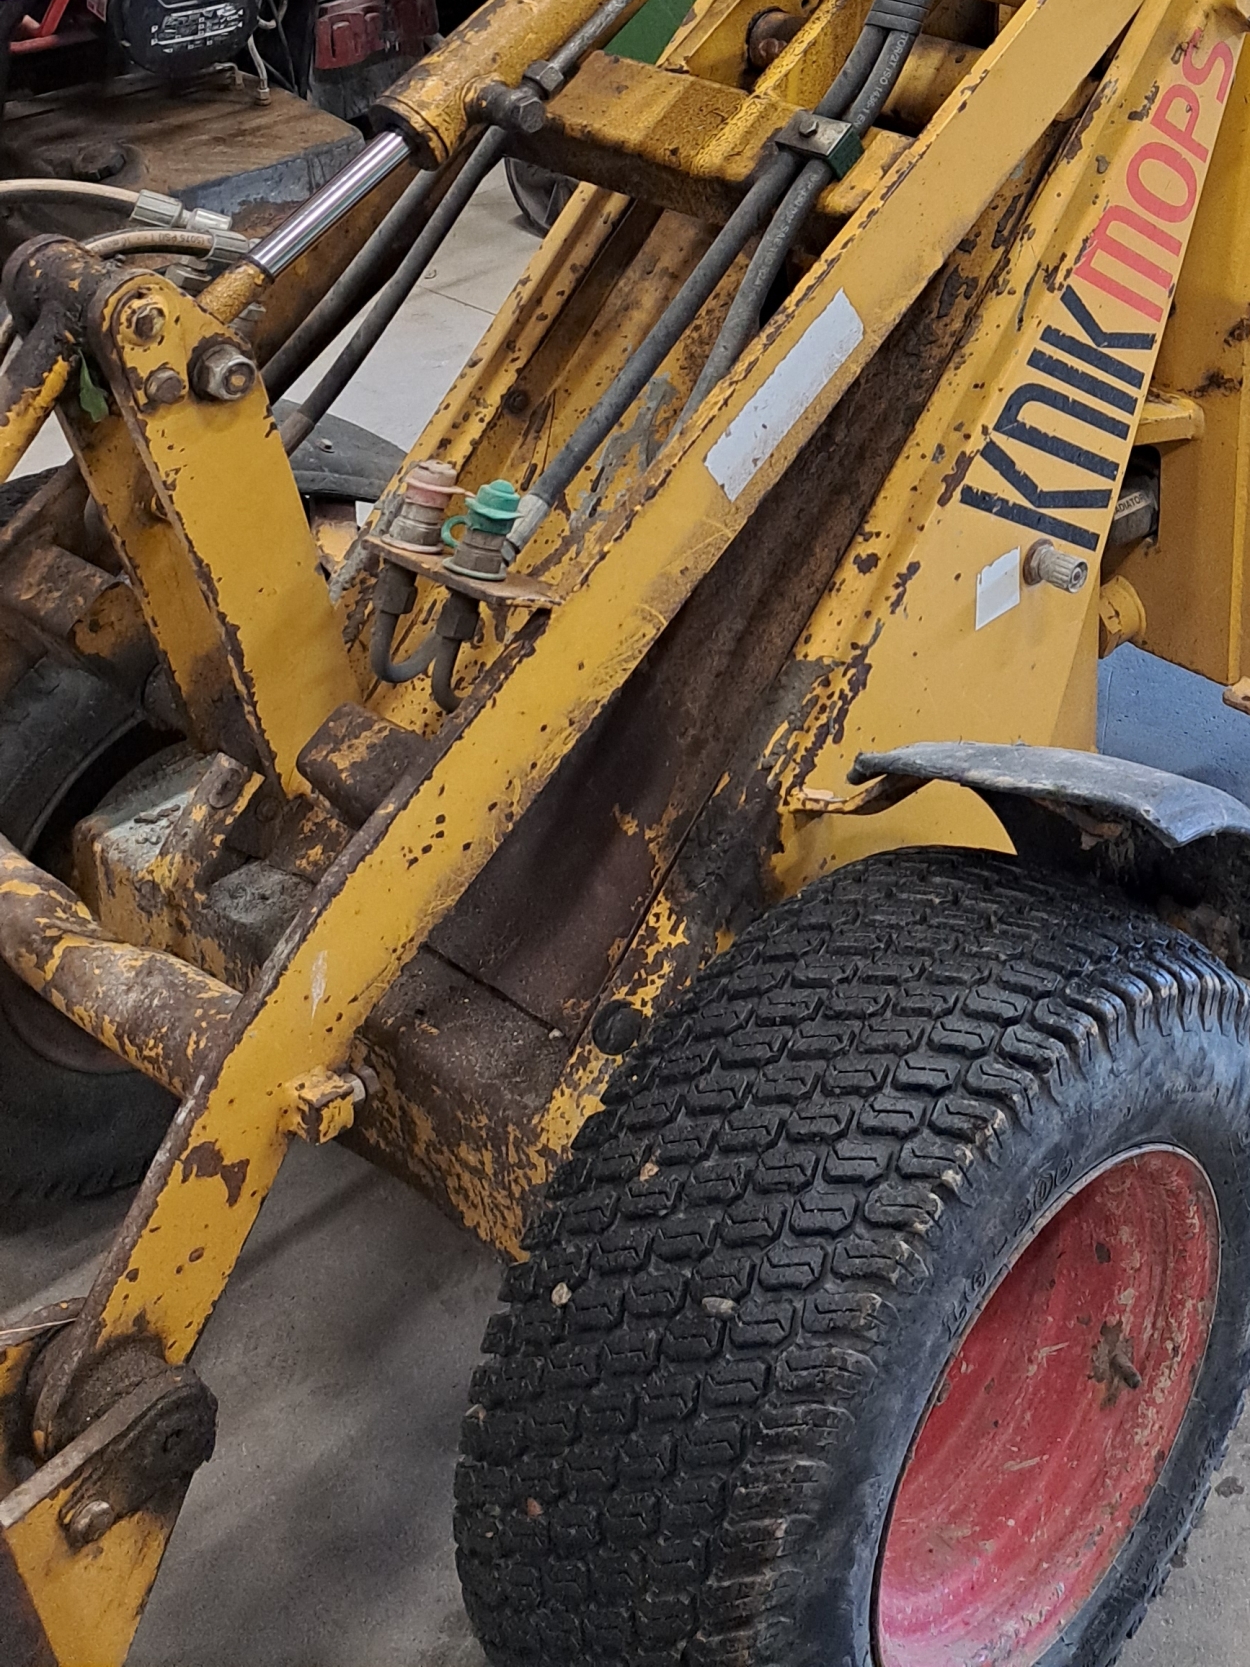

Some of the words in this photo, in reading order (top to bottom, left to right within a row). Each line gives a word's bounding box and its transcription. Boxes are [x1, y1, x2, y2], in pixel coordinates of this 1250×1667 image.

[879, 67, 893, 86] ISO
[773, 223, 790, 246] SAE
[960, 28, 1234, 552] KNIKMOPS
